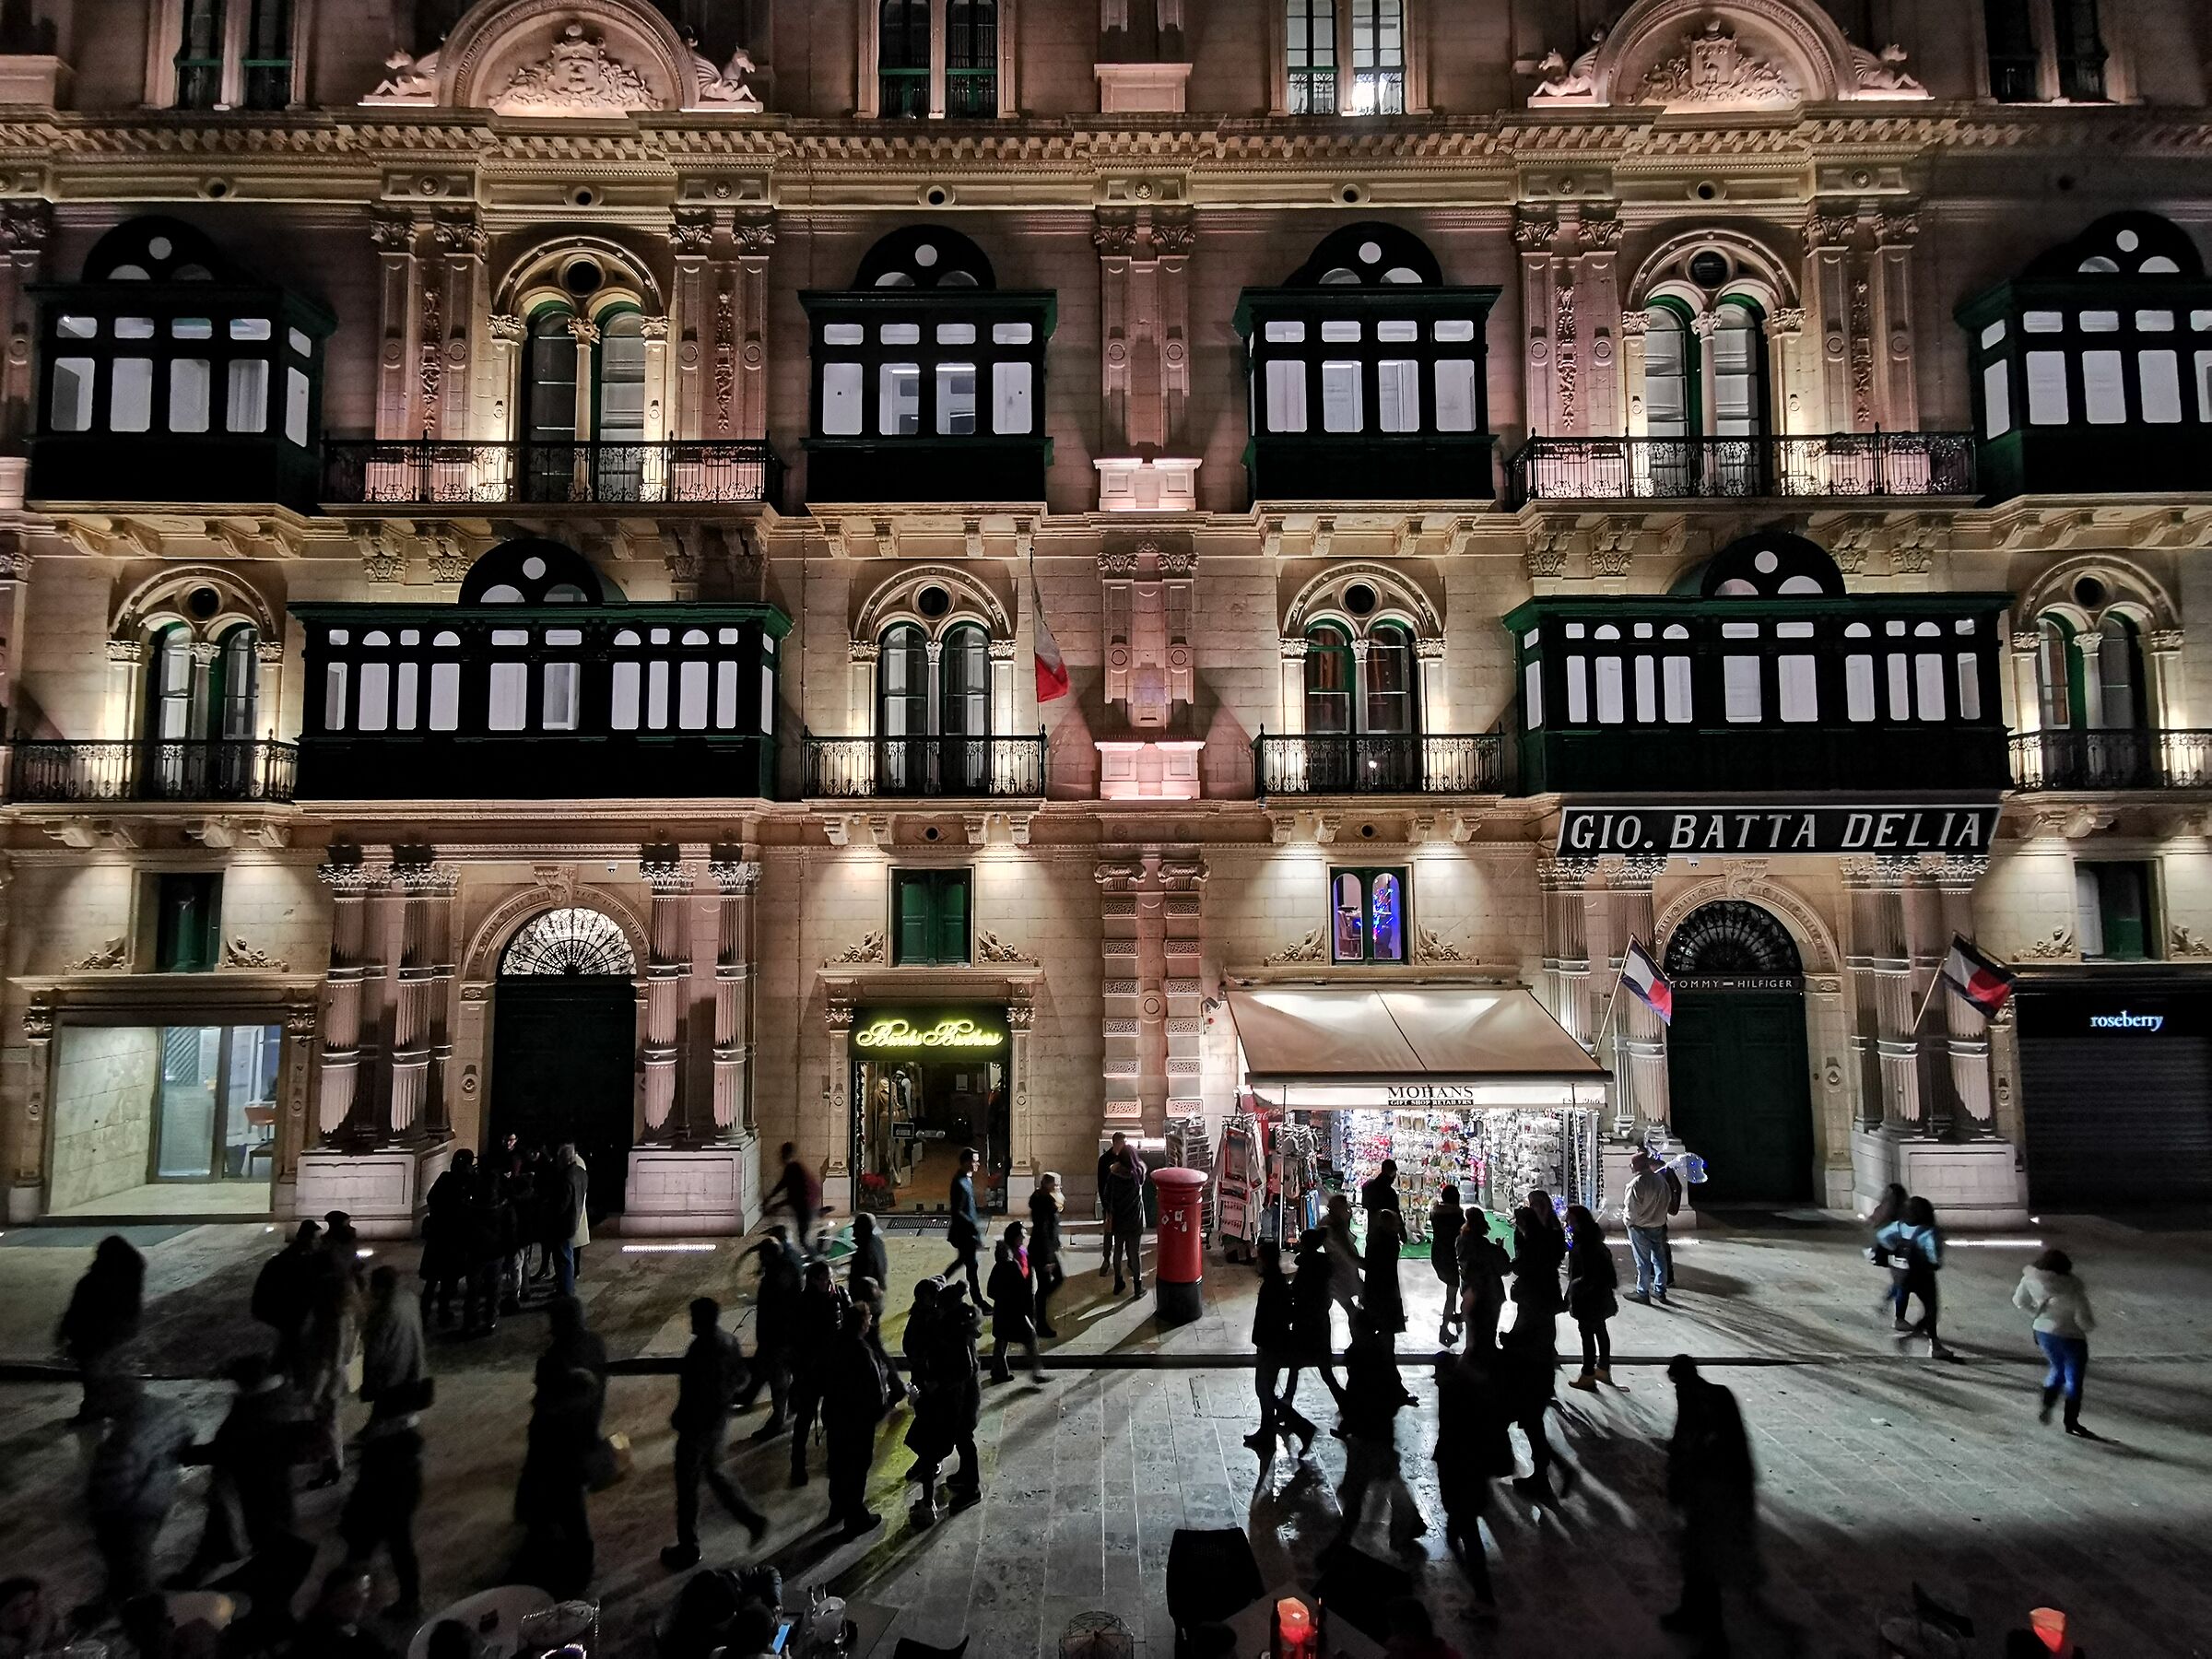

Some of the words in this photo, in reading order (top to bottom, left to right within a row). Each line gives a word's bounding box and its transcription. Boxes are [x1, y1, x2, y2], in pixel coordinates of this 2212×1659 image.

[1571, 814, 1653, 849] GIO.
[1669, 814, 1817, 848] BATTA
[1841, 812, 1980, 847] DELIA
[1670, 980, 1719, 989] TOMMY
[1737, 980, 1793, 988] HILFIGER
[2089, 1009, 2164, 1032] roseberry
[855, 1018, 922, 1047] Brooks
[922, 1018, 1004, 1047] Brothers
[1387, 1086, 1474, 1099] MOHANS
